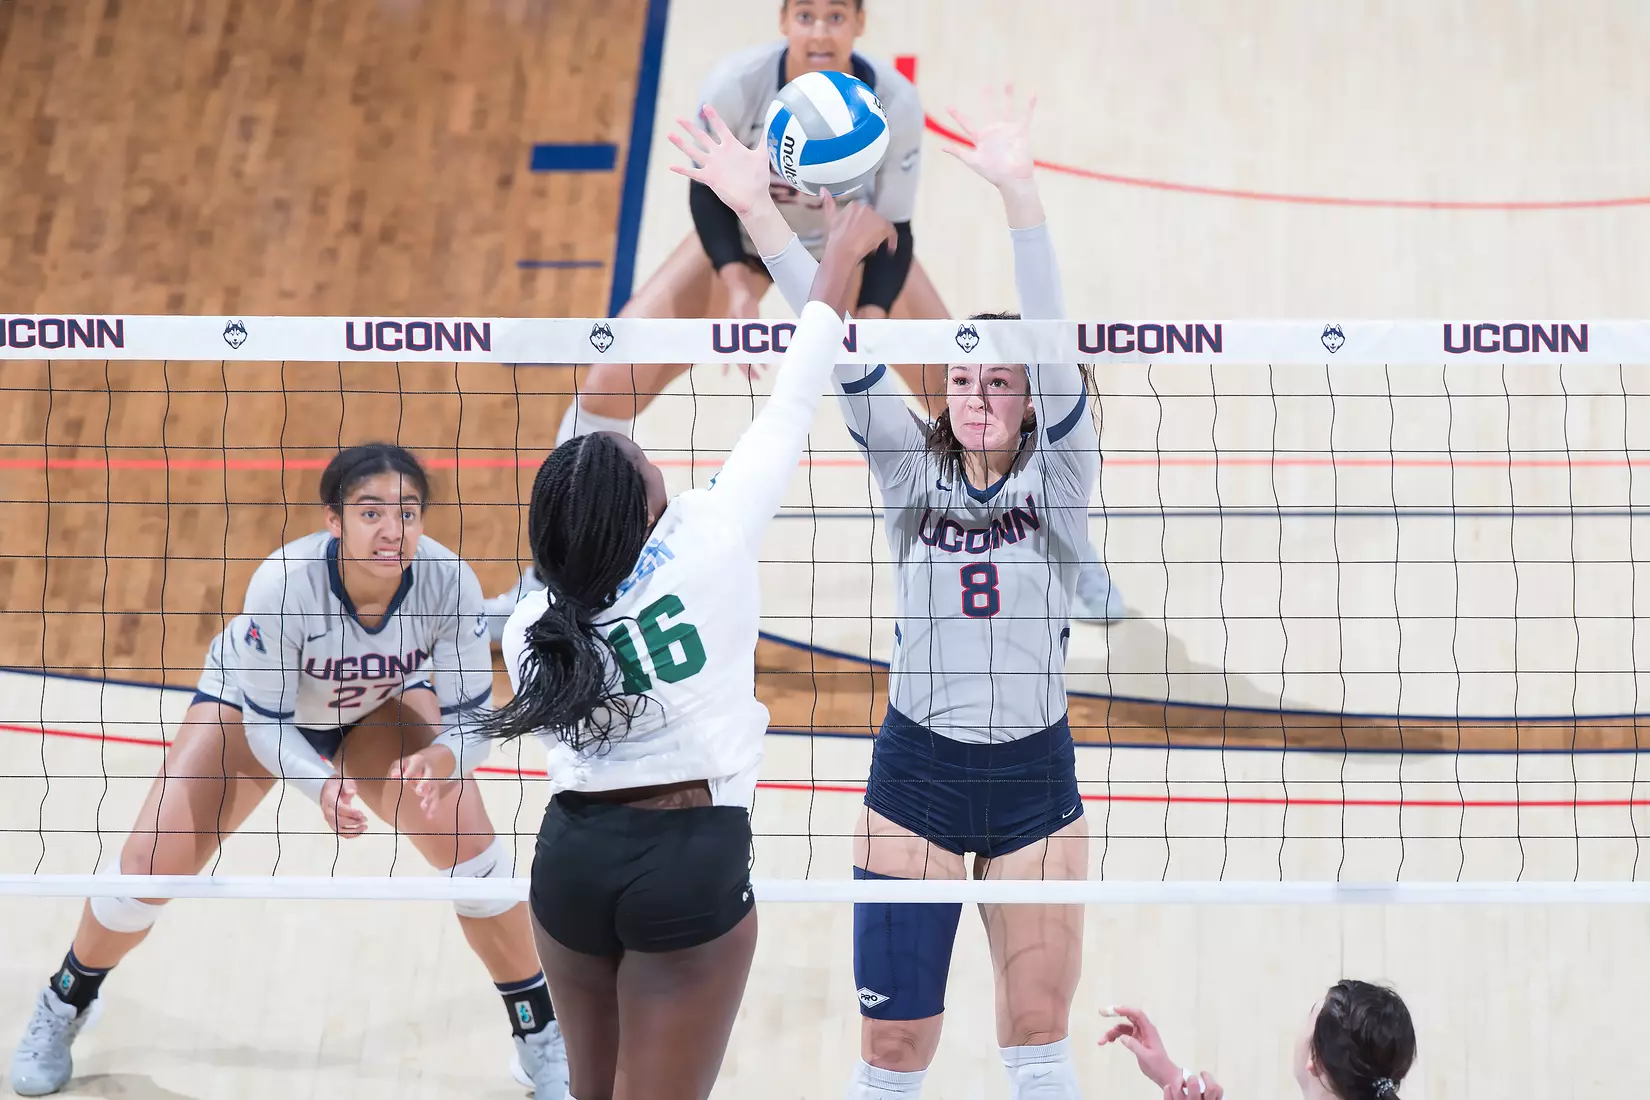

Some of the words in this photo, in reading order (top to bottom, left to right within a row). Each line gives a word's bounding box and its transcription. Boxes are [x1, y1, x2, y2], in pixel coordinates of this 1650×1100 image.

[783, 135, 802, 190] molte
[0, 318, 124, 349] CONN
[345, 321, 491, 352] UCONN
[1077, 323, 1223, 354] UCONN
[1443, 323, 1589, 354] UCONN
[918, 494, 1041, 555] UCONN
[959, 562, 1001, 619] 8
[607, 594, 708, 697] 16
[328, 682, 402, 709] 27
[860, 993, 878, 1002] PRO
